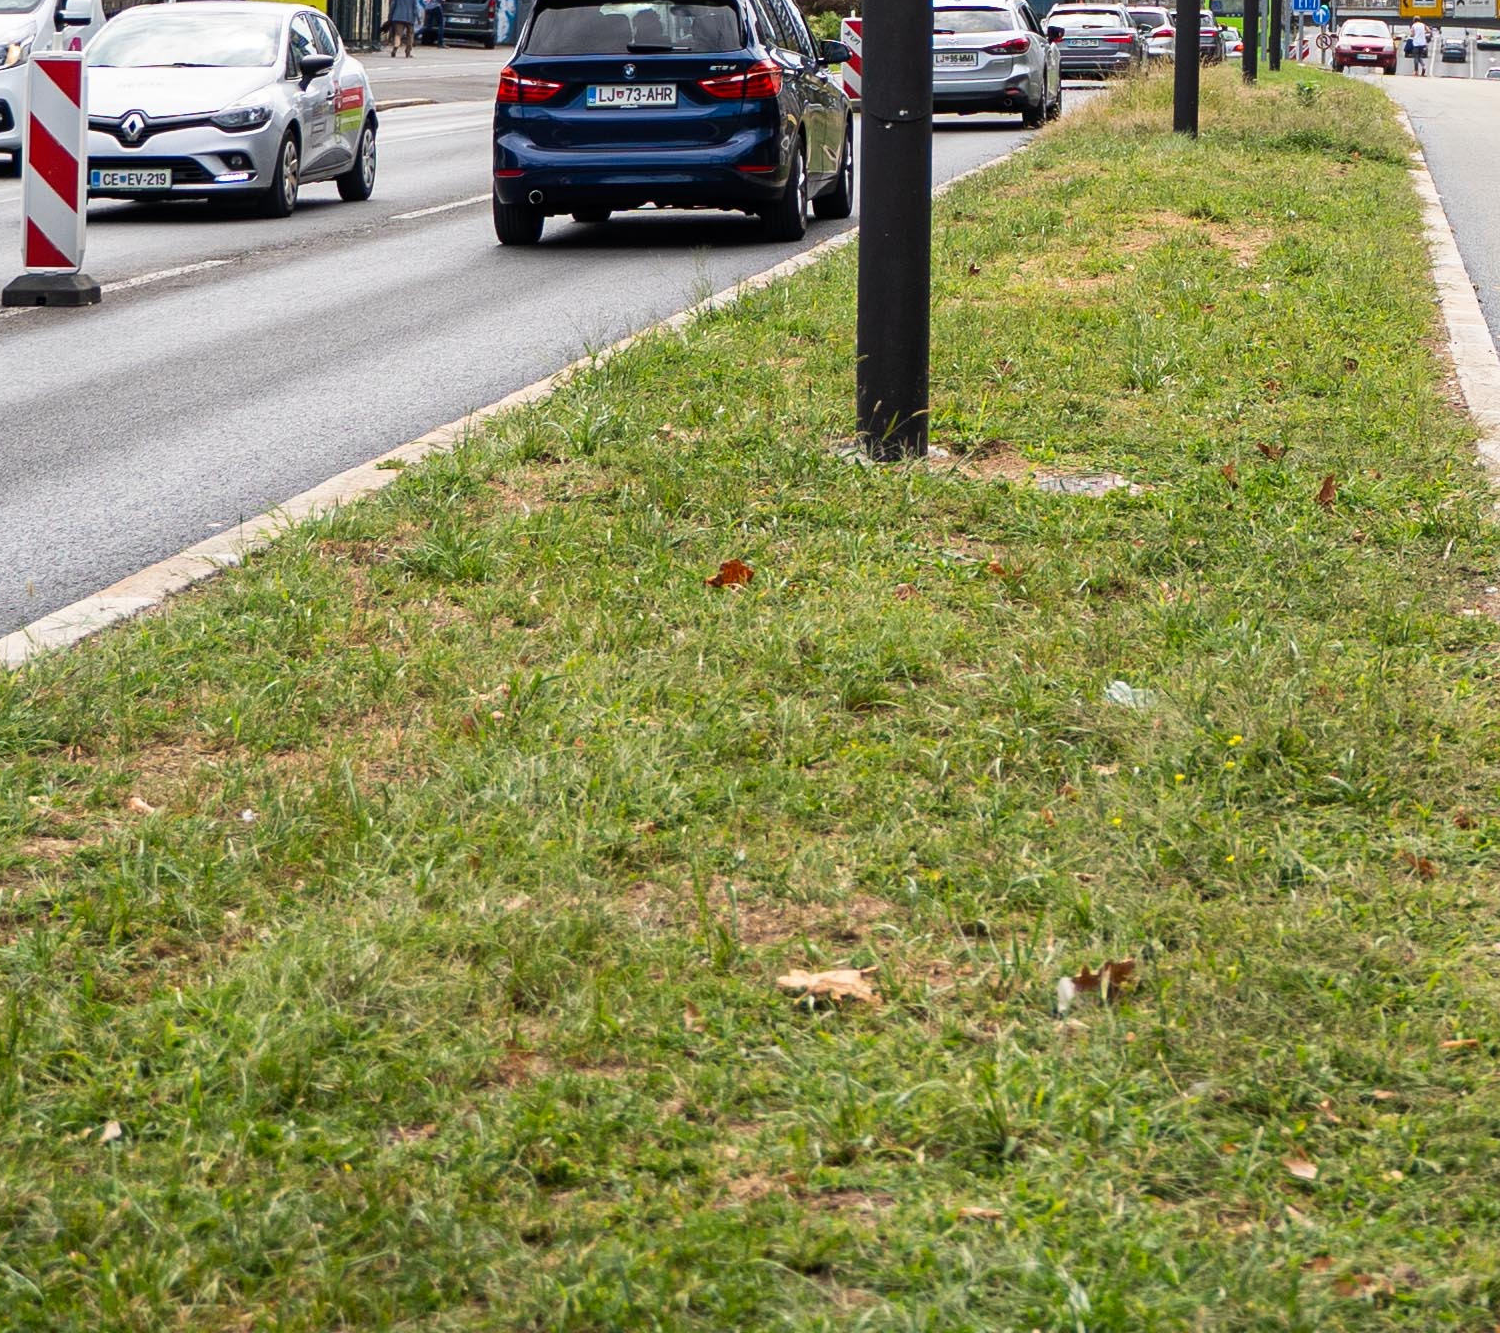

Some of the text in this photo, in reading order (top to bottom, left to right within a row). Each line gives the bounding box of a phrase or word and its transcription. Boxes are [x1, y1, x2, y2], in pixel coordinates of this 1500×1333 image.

[599, 87, 673, 102] LJ 73-AHR
[103, 173, 166, 185] CE EV-219
